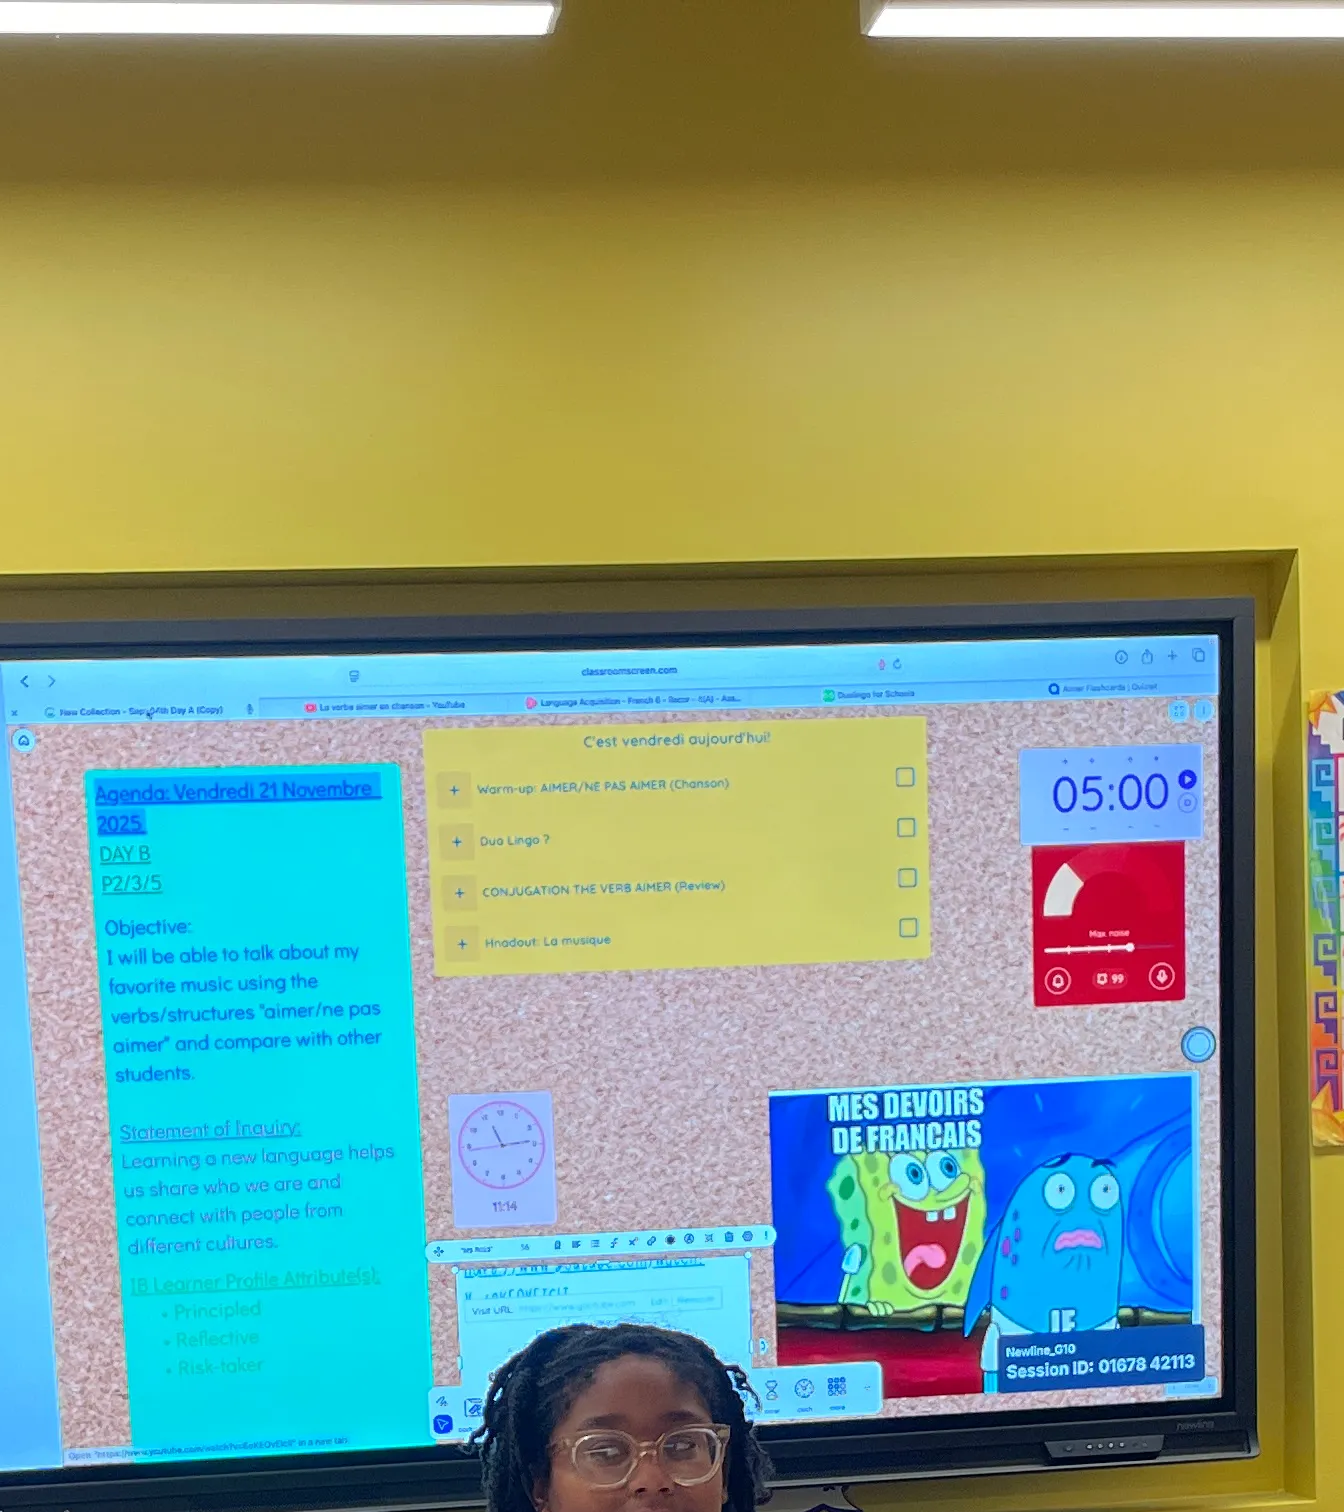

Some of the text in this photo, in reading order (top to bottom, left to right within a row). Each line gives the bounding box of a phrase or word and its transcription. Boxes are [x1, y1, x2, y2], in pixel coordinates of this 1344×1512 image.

[581, 667, 677, 677] classroomscreen.com
[584, 731, 771, 748] C'est vendredi aujourd'hui!
[94, 778, 373, 805] Agenda: Vendredi 21 Novembre
[477, 778, 730, 798] Warm-up: AIMER/NE PAS AIMER (Chanson)
[1053, 773, 1169, 813] 05:00
[97, 816, 142, 833] 2025
[480, 834, 550, 848] Duo Lingo ?
[99, 845, 151, 863] DAY B
[101, 874, 163, 892] P2/3/5
[482, 880, 725, 898] CONJUGATION THE VERB AIMER (Review)
[104, 918, 193, 939] Objective:
[485, 935, 611, 949] Hnadout: La musique
[117, 947, 147, 965] will
[152, 947, 174, 965] be
[179, 946, 218, 964] able
[222, 947, 239, 963] to
[243, 945, 274, 962] talk
[278, 943, 328, 962] about
[333, 944, 359, 962] my
[108, 971, 319, 996] favorite music using the
[1112, 973, 1125, 984] 99
[111, 1001, 381, 1025] verbs/structures "aimer/ne pas
[113, 1028, 382, 1054] aimer" and compare with other
[115, 1064, 196, 1083] students.
[828, 1088, 984, 1122] MES DEVOIRS
[120, 1119, 301, 1141] Statement of Inquiry:
[832, 1126, 862, 1154] DE
[492, 1200, 518, 1212] 11:14
[1006, 1354, 1196, 1380] Session ID: 01678 42113
